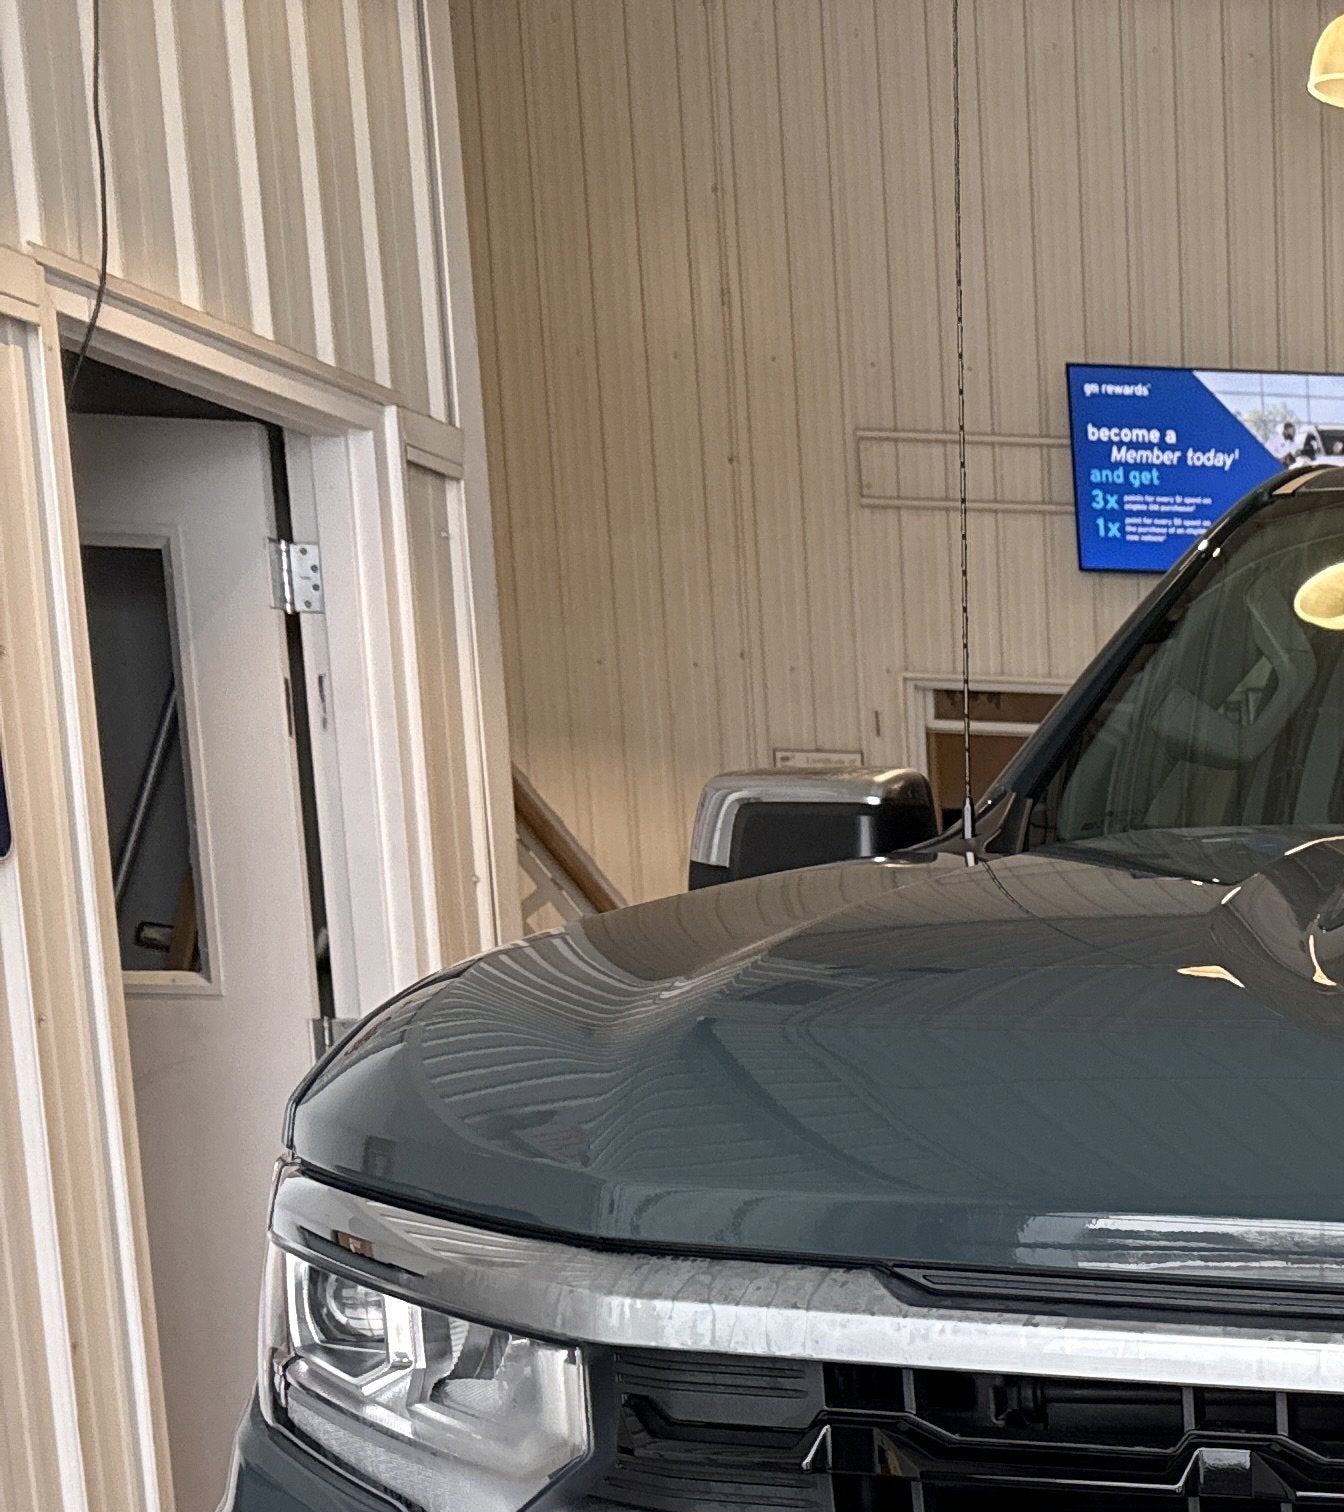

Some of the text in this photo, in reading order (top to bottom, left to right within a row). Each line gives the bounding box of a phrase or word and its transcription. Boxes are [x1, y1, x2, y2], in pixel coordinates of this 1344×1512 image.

[1087, 422, 1177, 444] become a
[1110, 445, 1182, 465] Member
[1089, 466, 1161, 488] and get
[1091, 488, 1120, 510] 3x
[1096, 517, 1122, 538] 1x
